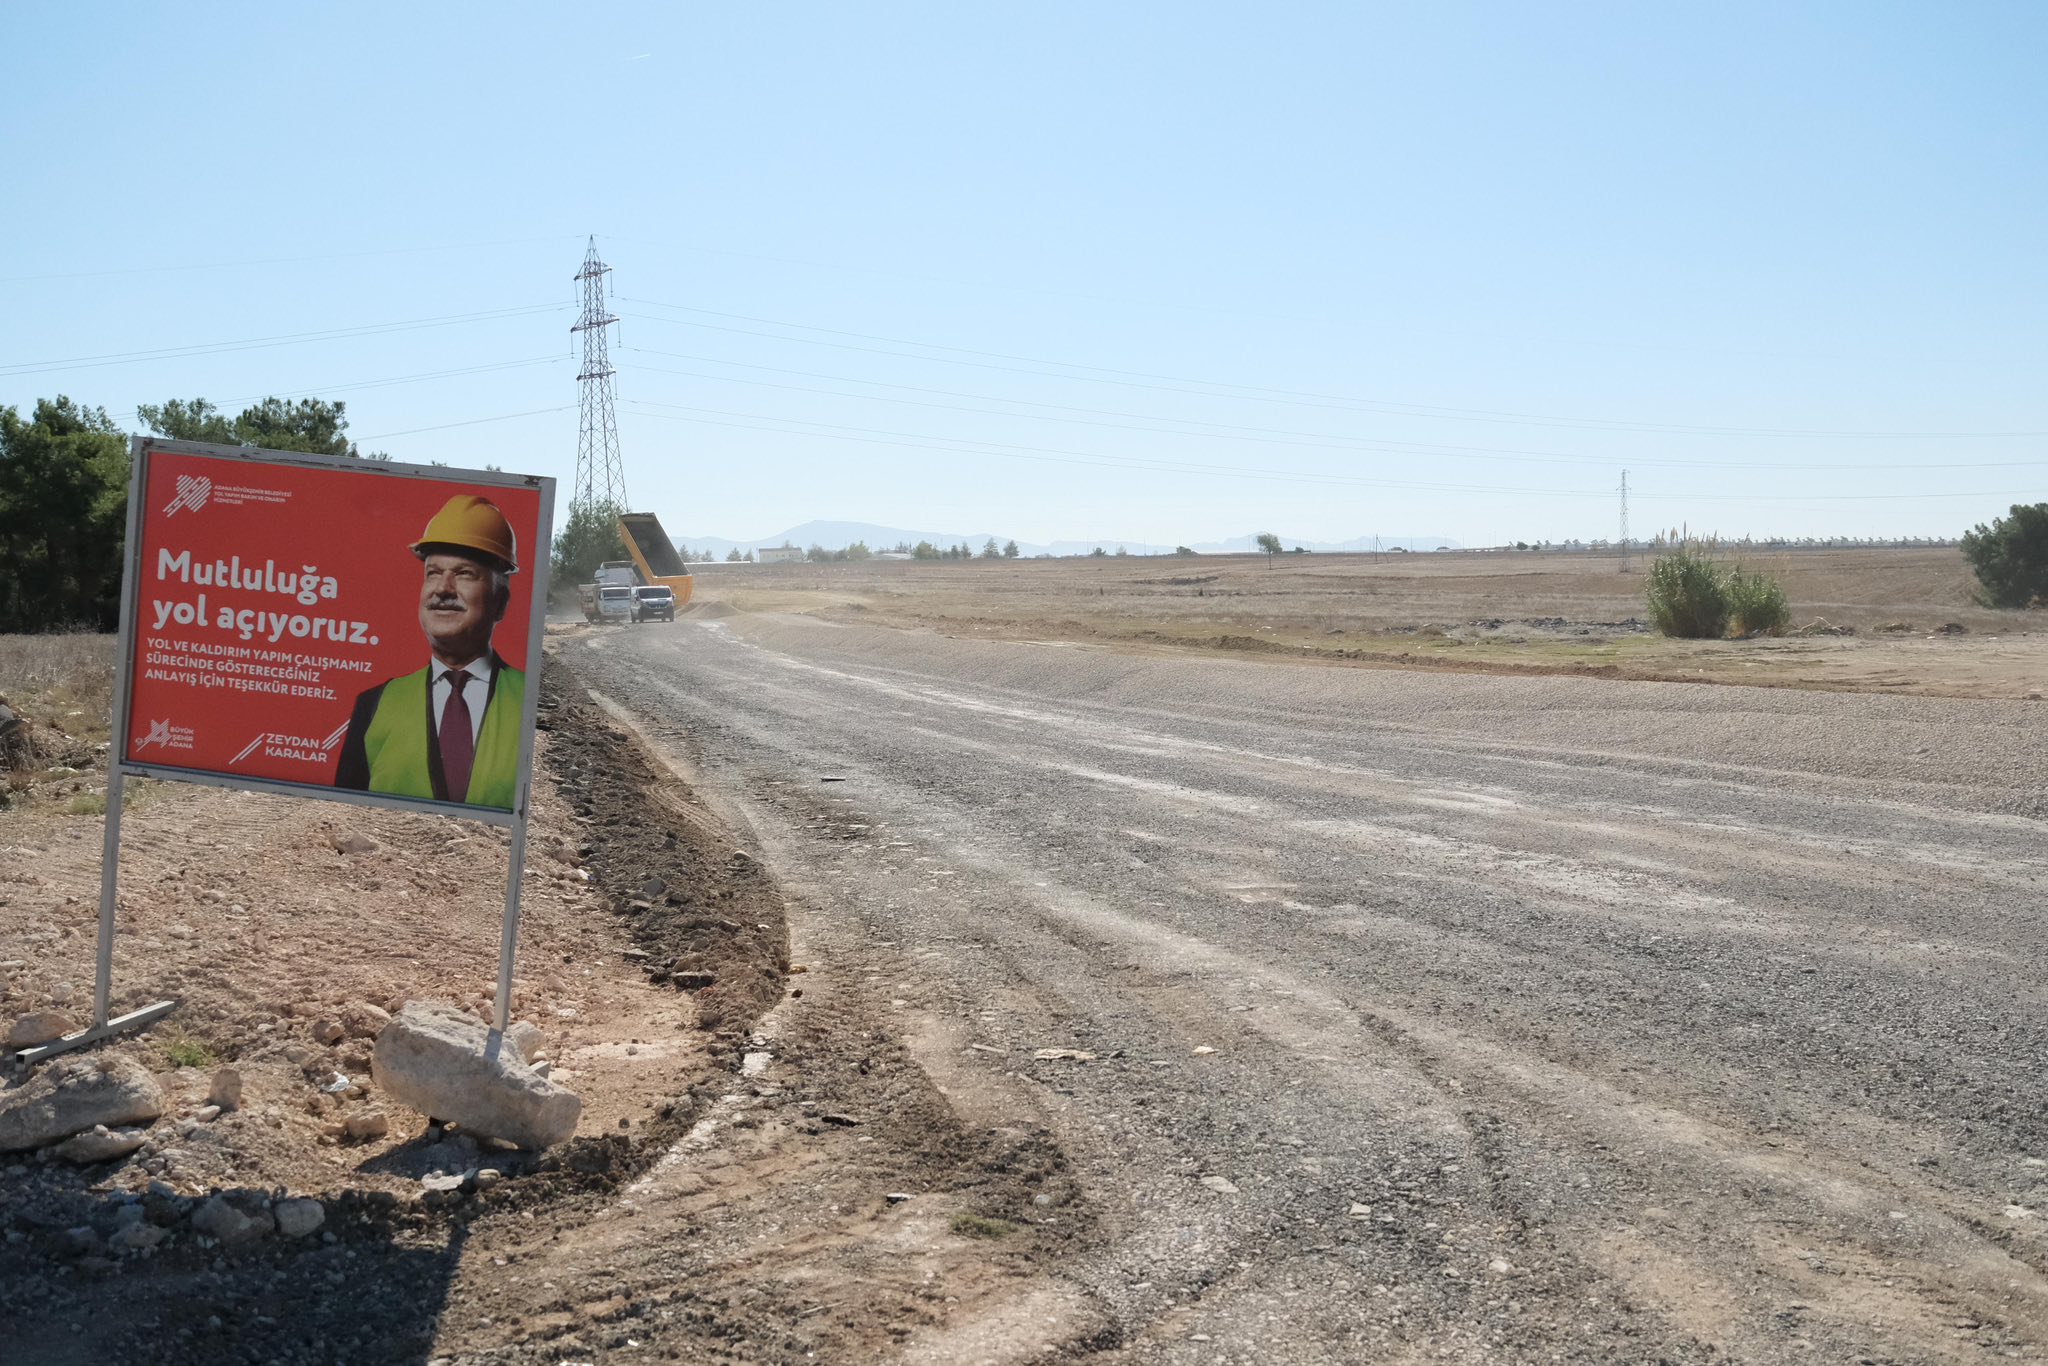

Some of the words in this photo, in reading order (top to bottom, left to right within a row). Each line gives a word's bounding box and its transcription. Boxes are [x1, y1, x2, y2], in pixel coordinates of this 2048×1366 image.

[158, 548, 338, 605] Mutluluğa
[153, 594, 208, 629] yol
[217, 606, 379, 645] açıyoruz.
[146, 652, 214, 671] SÜRECİNDE
[215, 661, 320, 683] GÖSTERECEĞİNİZ
[147, 638, 171, 652] YOL
[173, 640, 188, 652] VE
[191, 642, 251, 659] KALDIRIM
[253, 647, 293, 664] YAPIM
[294, 654, 372, 674] ÇALIŞMAMIZ
[145, 668, 197, 687] ANLAYIŞ
[199, 672, 225, 688] İÇİN
[227, 676, 289, 695] TEŞEKKÜR
[291, 682, 337, 700] EDERİZ.
[168, 741, 193, 749] ADANA
[170, 726, 194, 734] BÜYÜK
[266, 733, 320, 750] ZEYDAN
[265, 745, 328, 763] KARALAR
